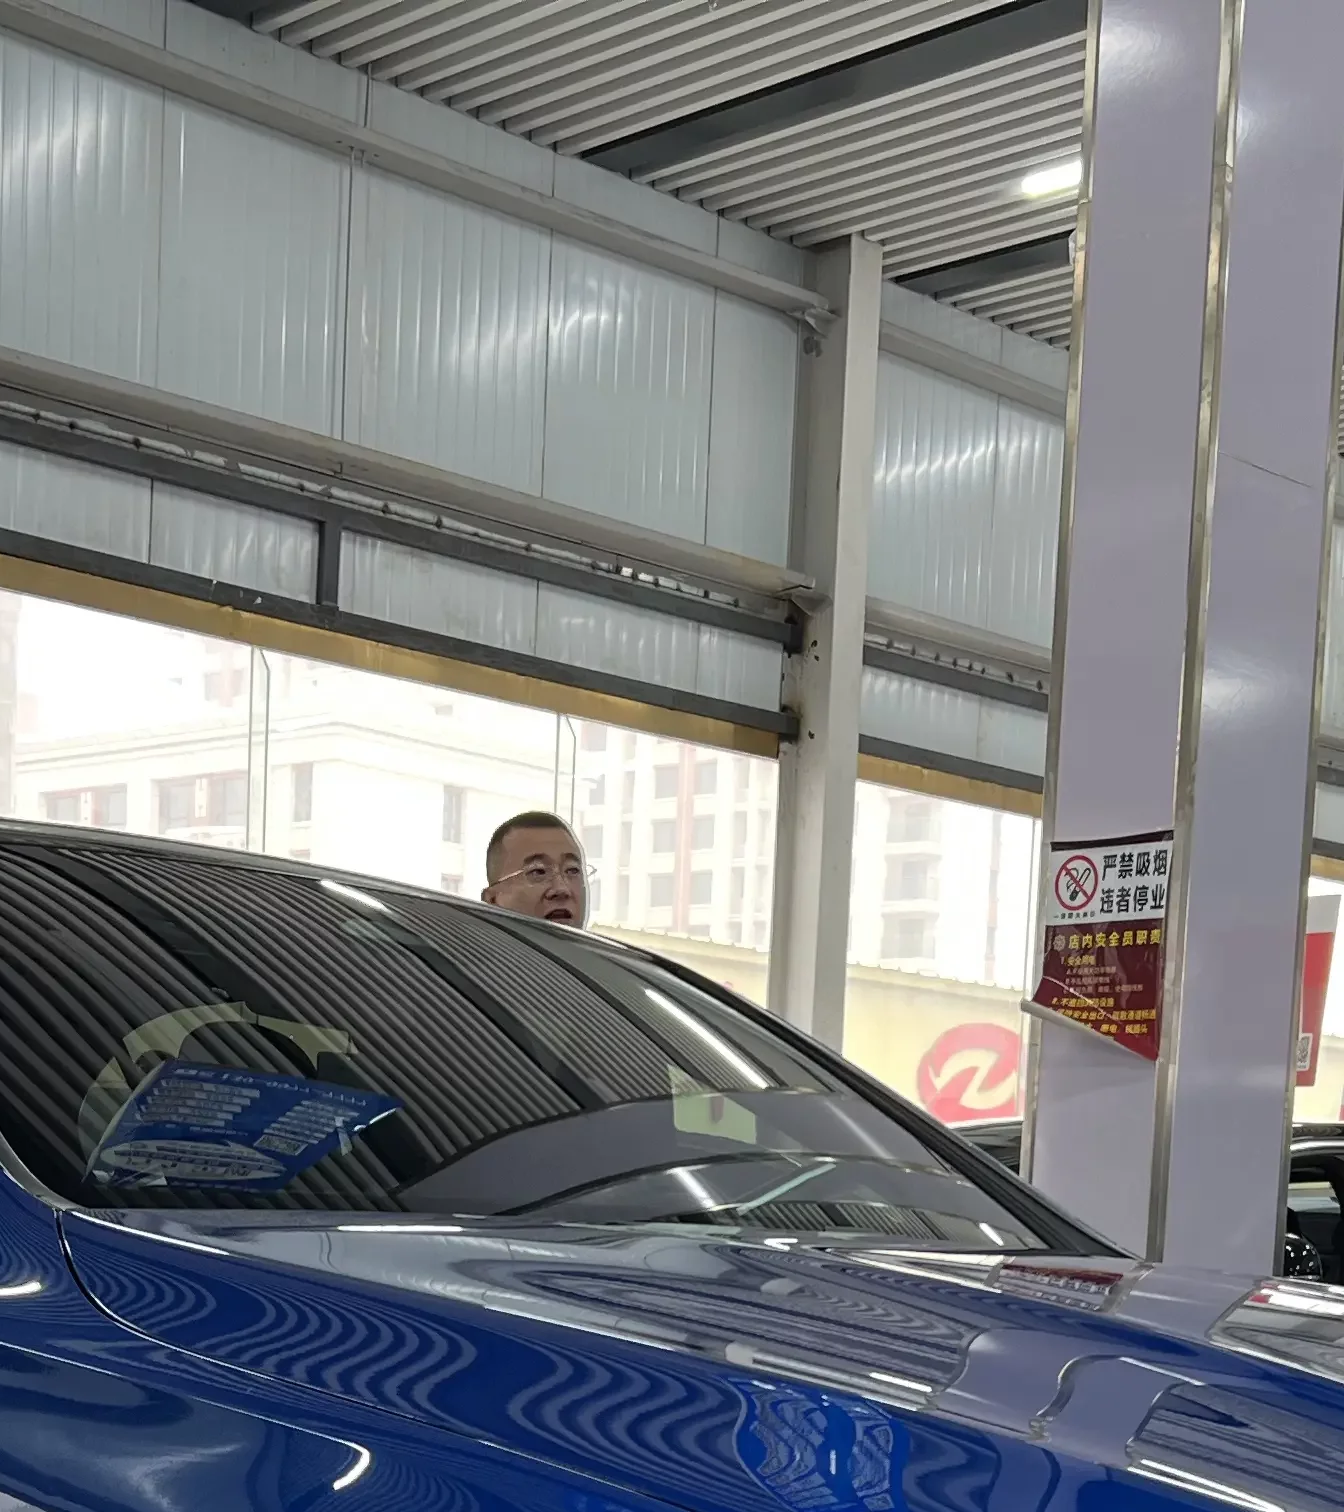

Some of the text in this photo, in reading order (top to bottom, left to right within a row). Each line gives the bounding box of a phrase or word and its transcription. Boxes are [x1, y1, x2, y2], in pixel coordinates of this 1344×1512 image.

[1102, 849, 1168, 881] 严禁吸烟
[1099, 883, 1165, 915] 违者停业
